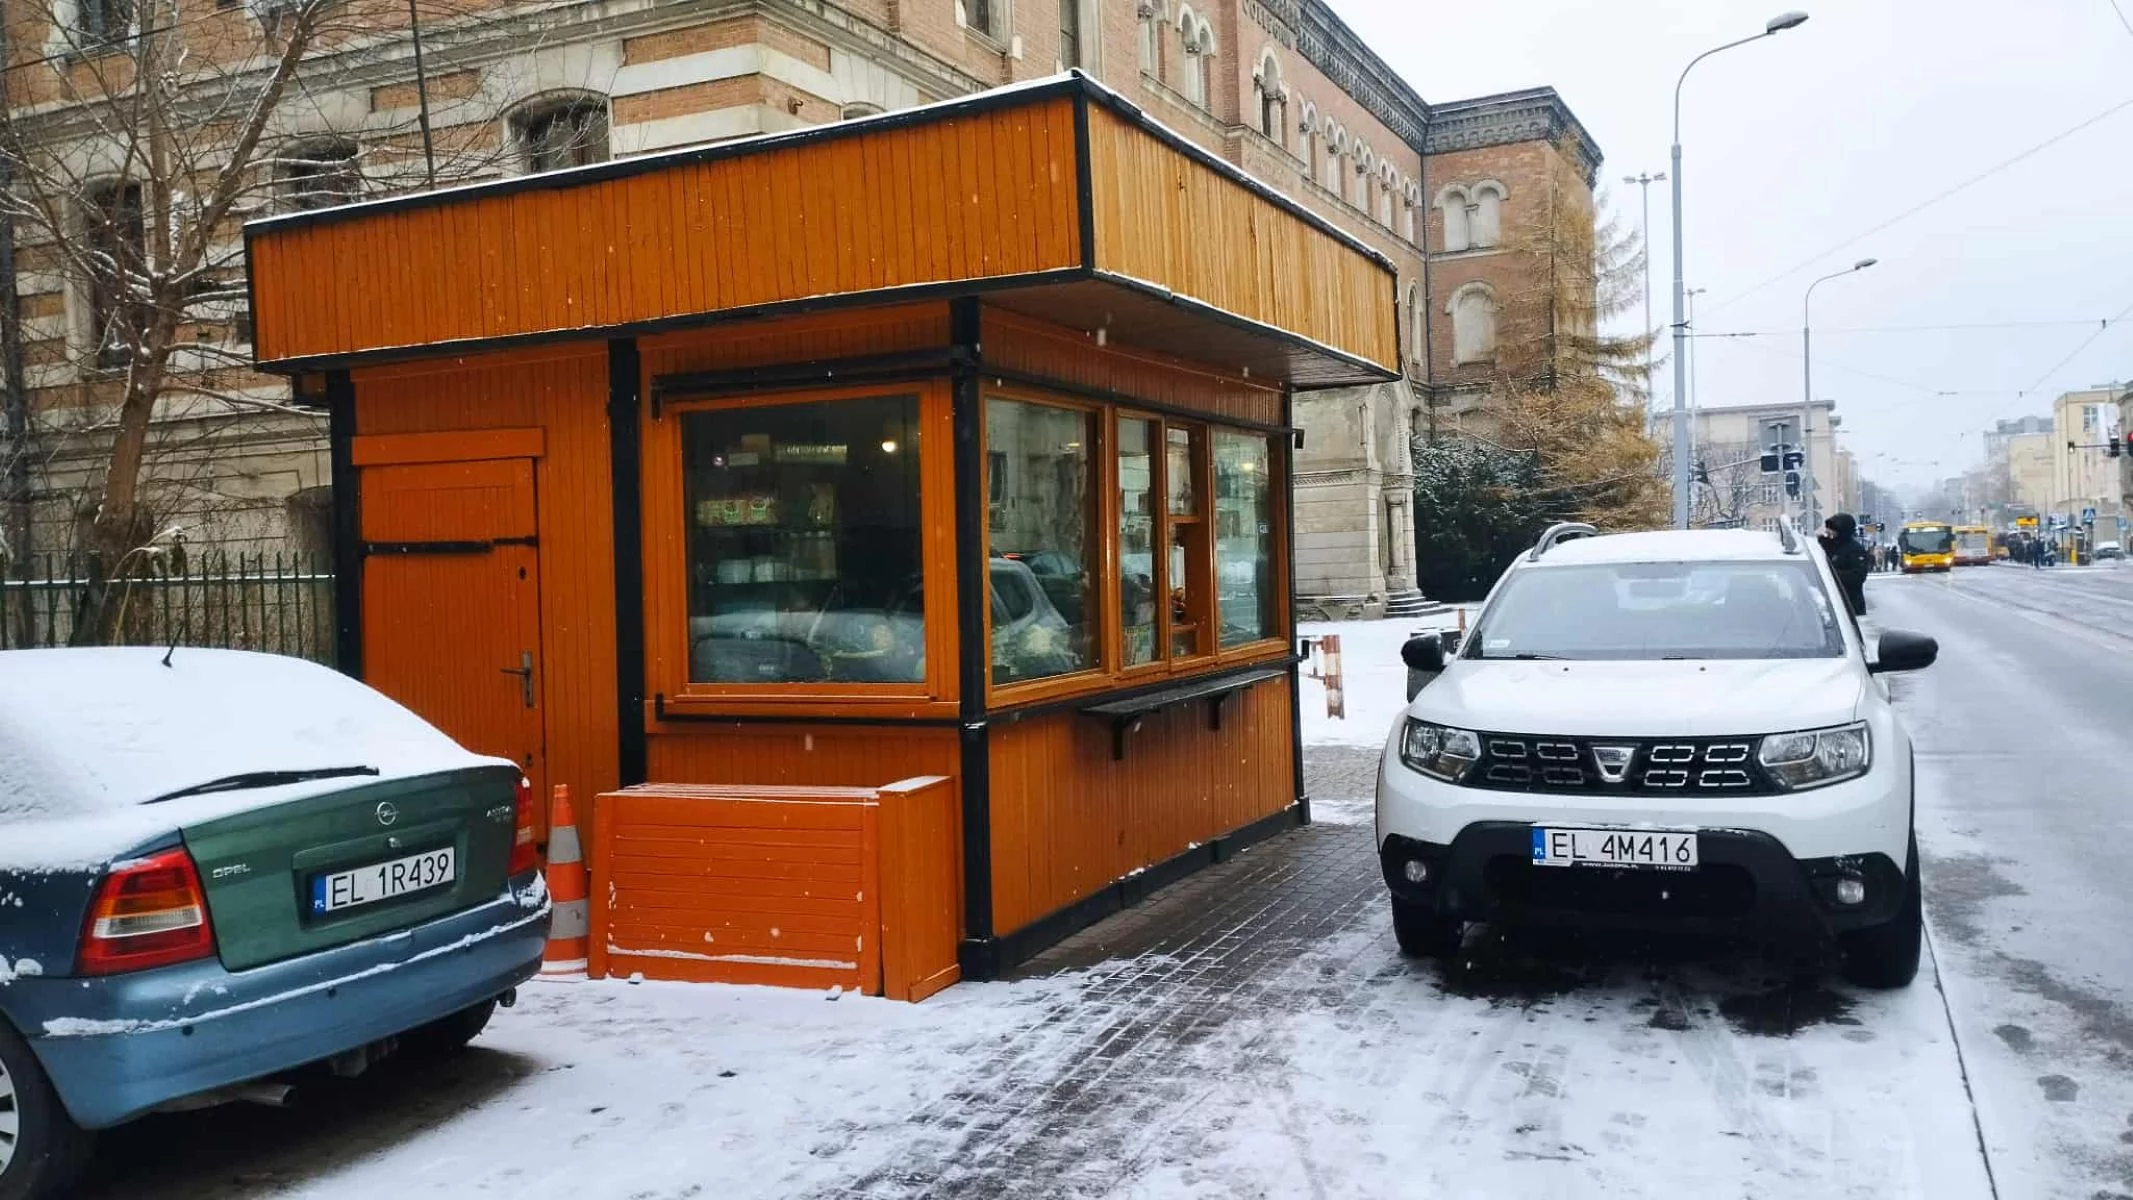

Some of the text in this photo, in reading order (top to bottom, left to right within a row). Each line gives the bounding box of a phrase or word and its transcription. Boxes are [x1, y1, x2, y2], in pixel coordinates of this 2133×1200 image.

[1552, 832, 1690, 863] EL 4M416
[211, 863, 251, 878] OPEL
[332, 853, 449, 907] EL 1R439
